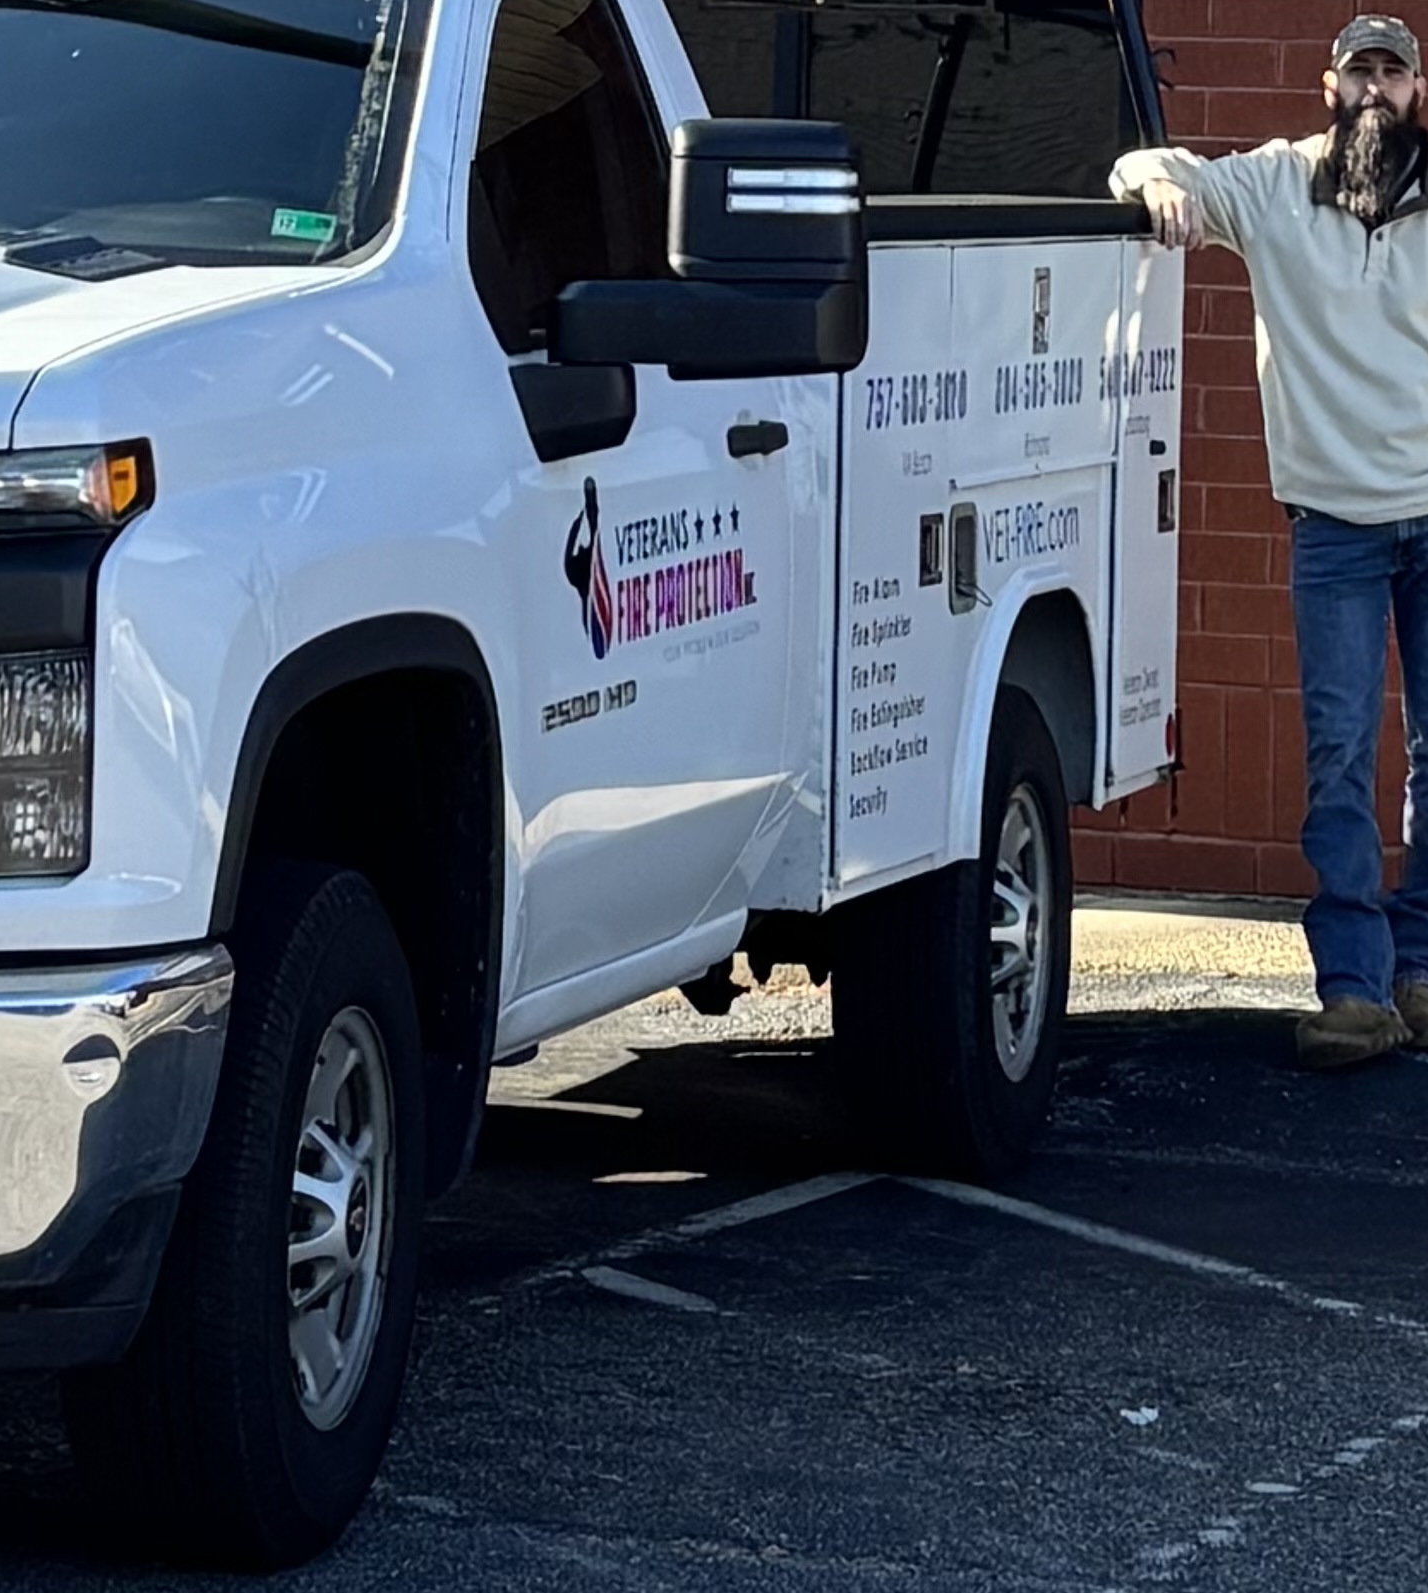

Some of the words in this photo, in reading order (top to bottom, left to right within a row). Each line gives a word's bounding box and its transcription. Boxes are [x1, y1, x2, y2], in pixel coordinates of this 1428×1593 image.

[614, 508, 690, 566] VETERANS
[616, 572, 652, 646] FIRE
[655, 547, 744, 634] PROTECTION
[541, 690, 601, 734] 2500
[603, 679, 638, 713] HD
